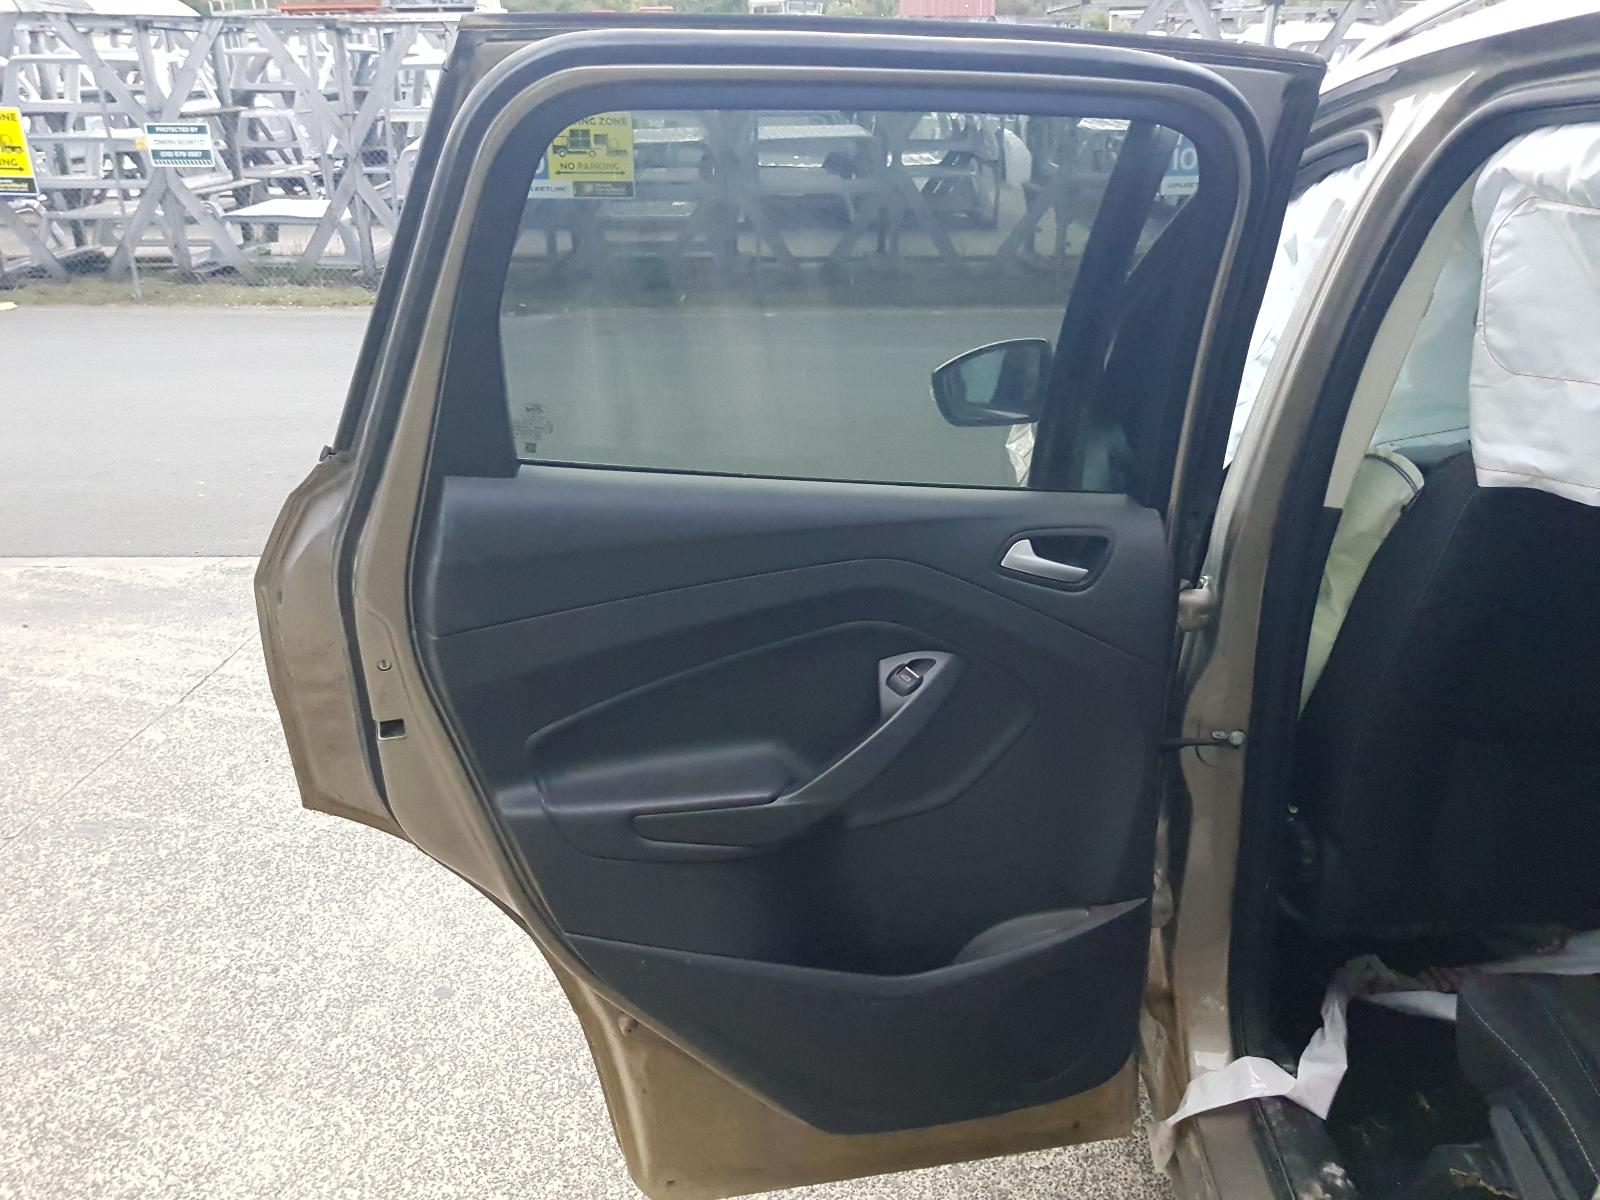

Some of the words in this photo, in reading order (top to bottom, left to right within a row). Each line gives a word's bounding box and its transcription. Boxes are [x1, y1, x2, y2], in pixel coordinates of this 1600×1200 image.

[598, 116, 627, 126] ZONE
[560, 161, 576, 170] NO
[577, 161, 620, 170] PARKING
